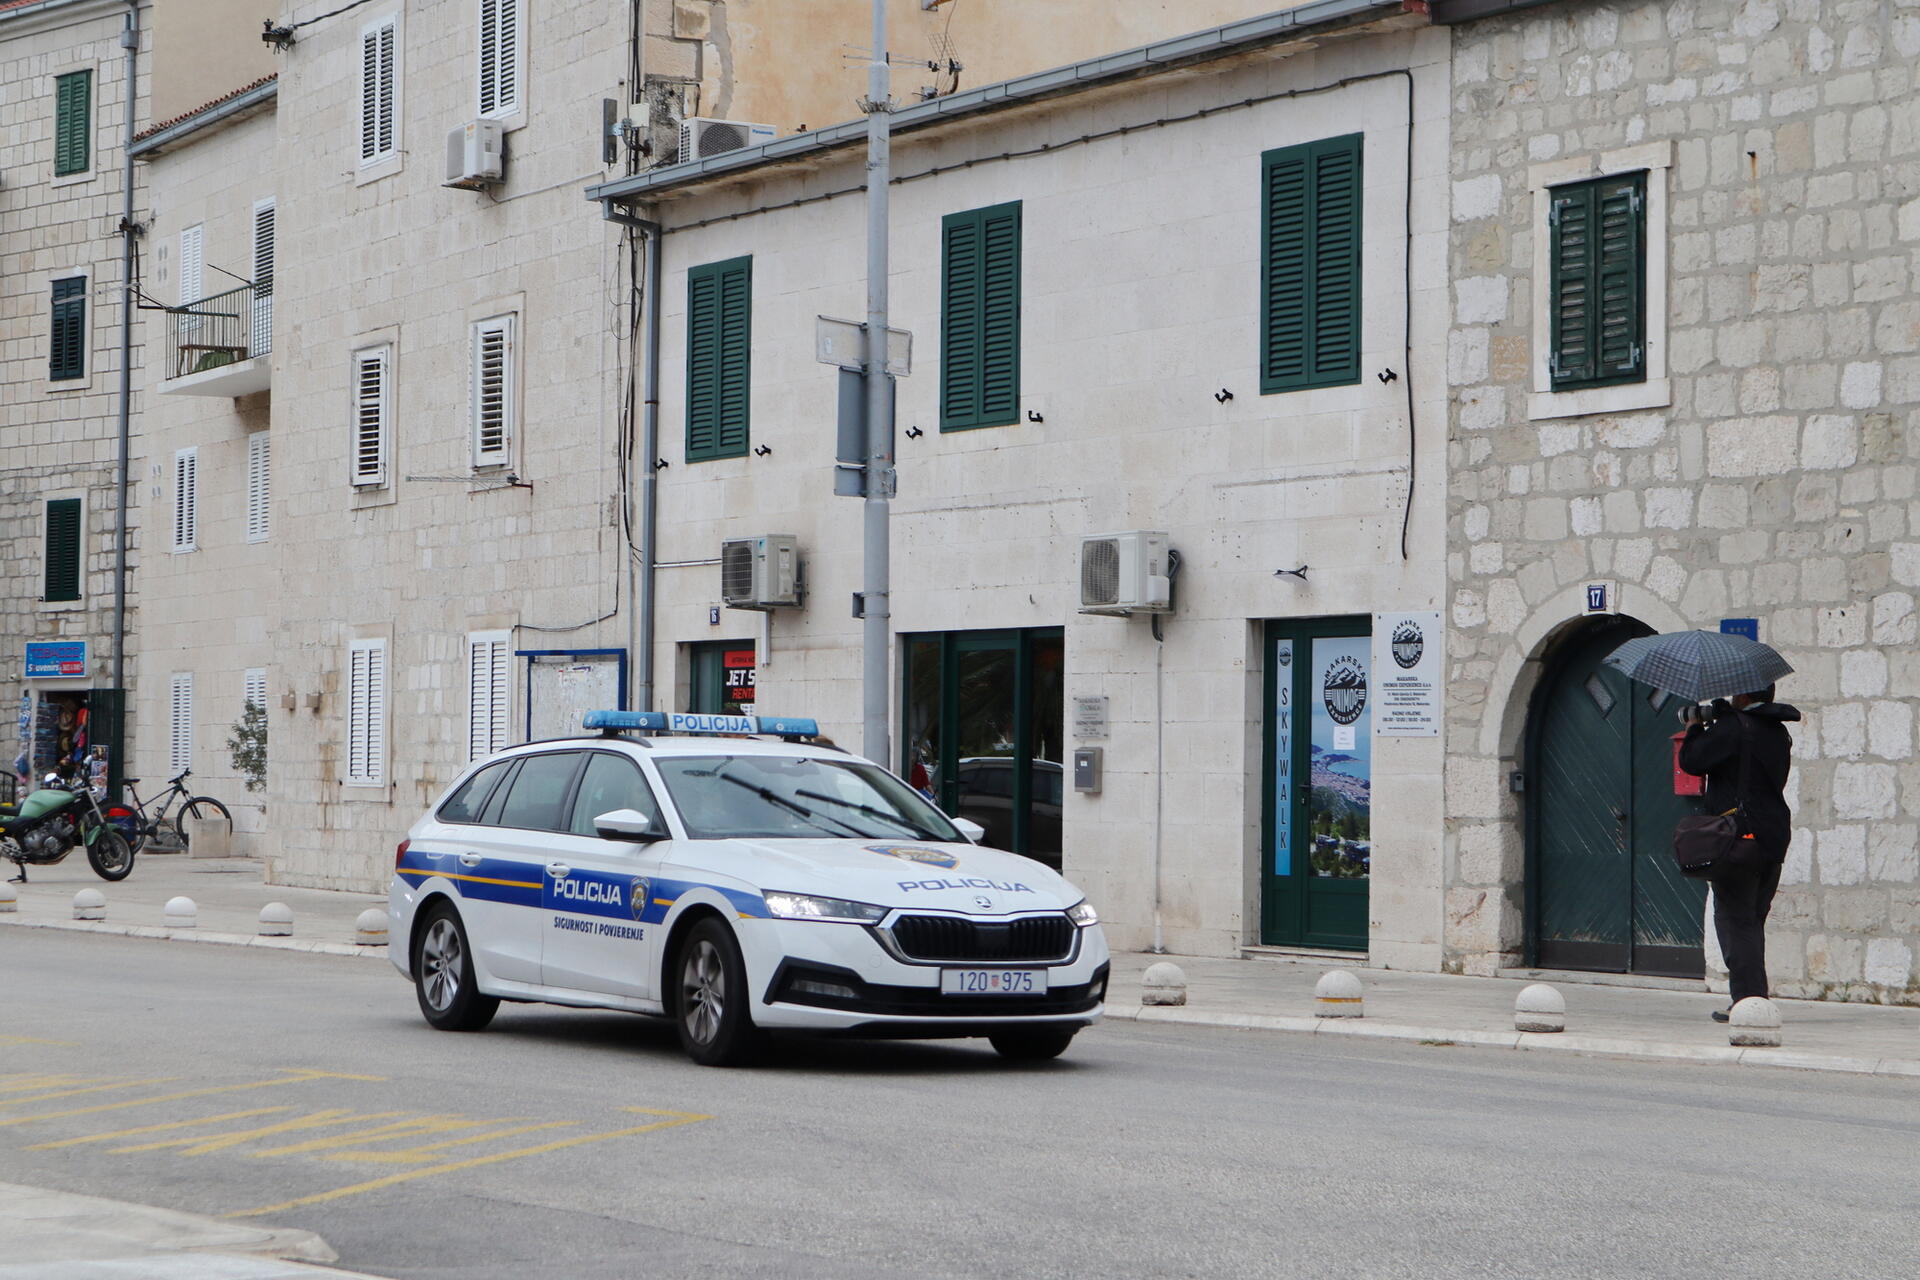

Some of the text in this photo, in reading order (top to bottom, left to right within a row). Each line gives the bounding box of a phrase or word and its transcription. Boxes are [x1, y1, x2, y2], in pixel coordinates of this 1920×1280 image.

[1590, 590, 1601, 607] 17
[726, 669, 746, 686] JET
[1324, 655, 1366, 680] MAKARSKA
[673, 714, 753, 732] POLICIJA
[1279, 686, 1289, 849] SKYWALK
[553, 878, 622, 906] POLICIJA
[897, 878, 1035, 894] POLICIJA
[553, 916, 644, 941] SIGURNOST I POVJERENJE
[959, 972, 1032, 993] 120 975
[22, 1105, 583, 1163] TAXI
